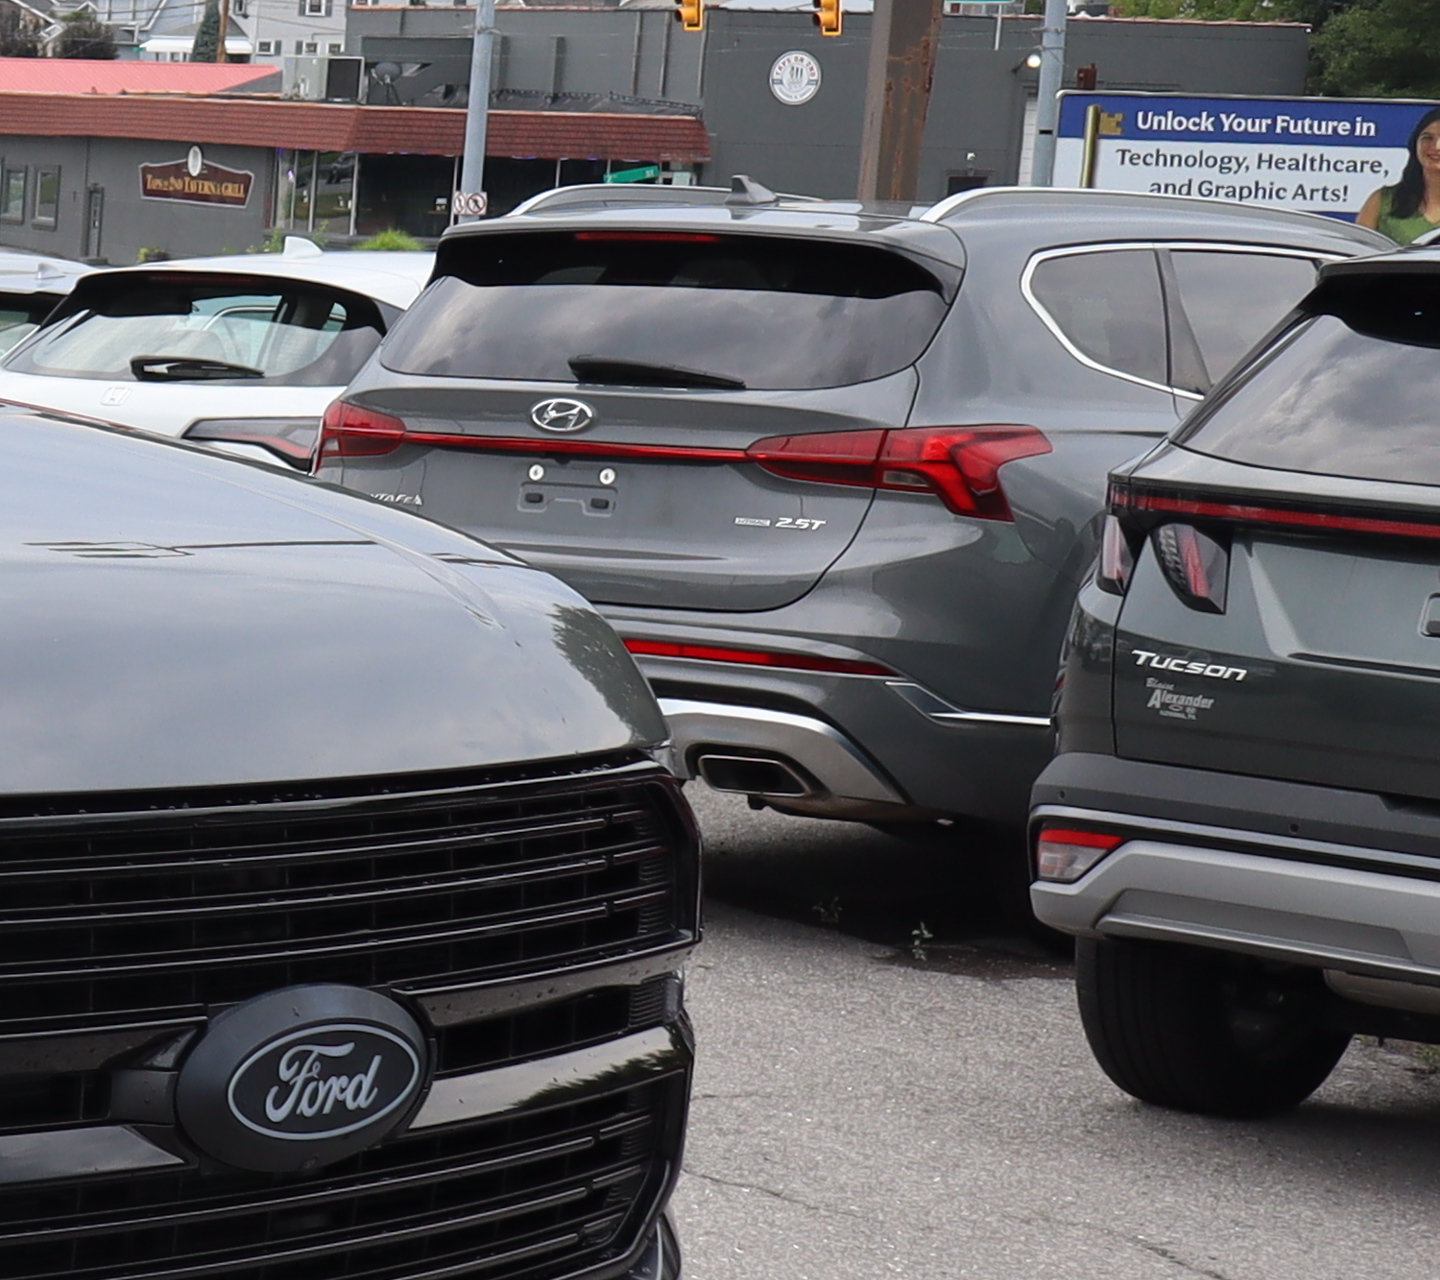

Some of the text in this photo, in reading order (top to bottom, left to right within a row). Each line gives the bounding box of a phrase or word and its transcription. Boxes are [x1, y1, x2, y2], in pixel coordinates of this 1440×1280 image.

[1137, 110, 1377, 137] Unlock Your Future in
[1115, 148, 1389, 178] Technology, Healthcare,
[1149, 178, 1349, 203] and Graphic Arts!
[1131, 649, 1247, 681] TUCSON
[1147, 689, 1215, 709] Alexander
[265, 1041, 383, 1123] Ford
